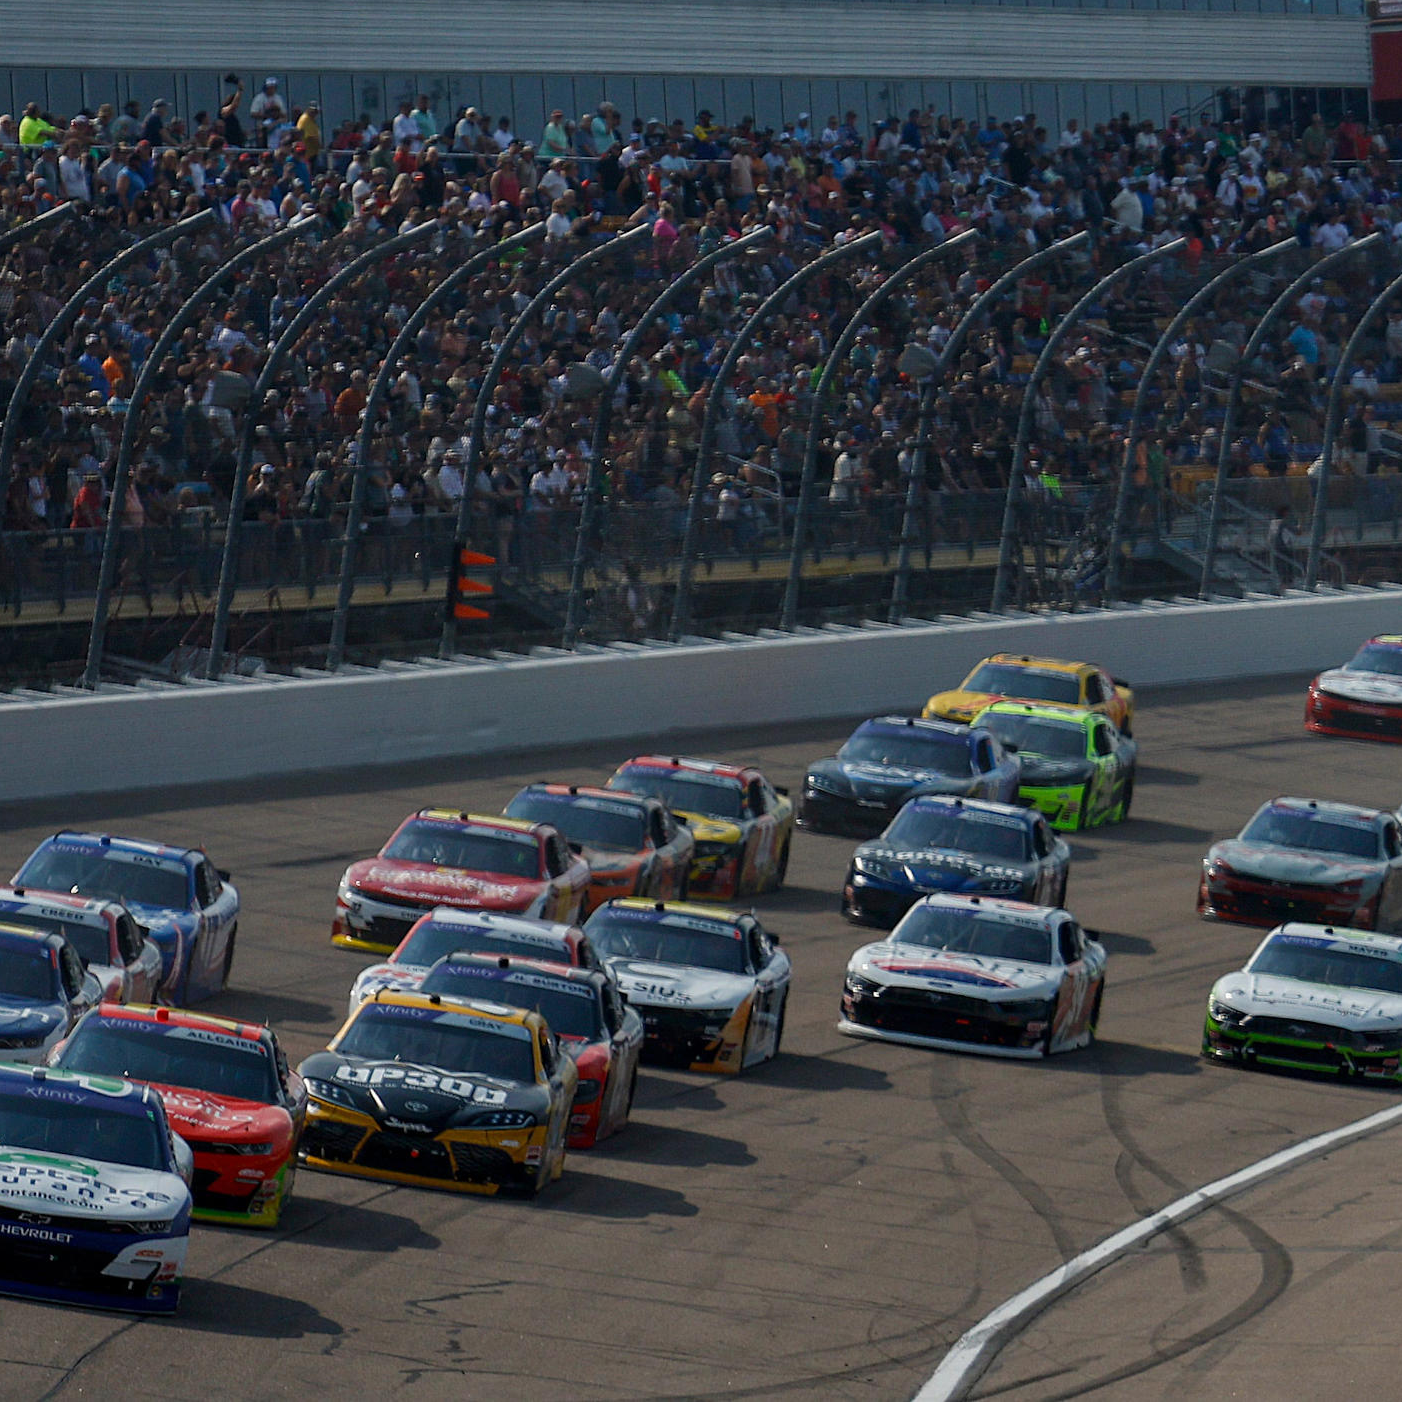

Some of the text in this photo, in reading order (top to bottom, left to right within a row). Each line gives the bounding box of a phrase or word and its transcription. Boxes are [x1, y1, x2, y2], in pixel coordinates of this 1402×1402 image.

[41, 907, 85, 921] CREED
[617, 980, 693, 1003] LSIUS
[375, 1004, 428, 1018] xfinity
[99, 1018, 155, 1032] xfinity
[187, 1029, 259, 1050] ALLGAIER
[24, 1086, 88, 1104] xfinity
